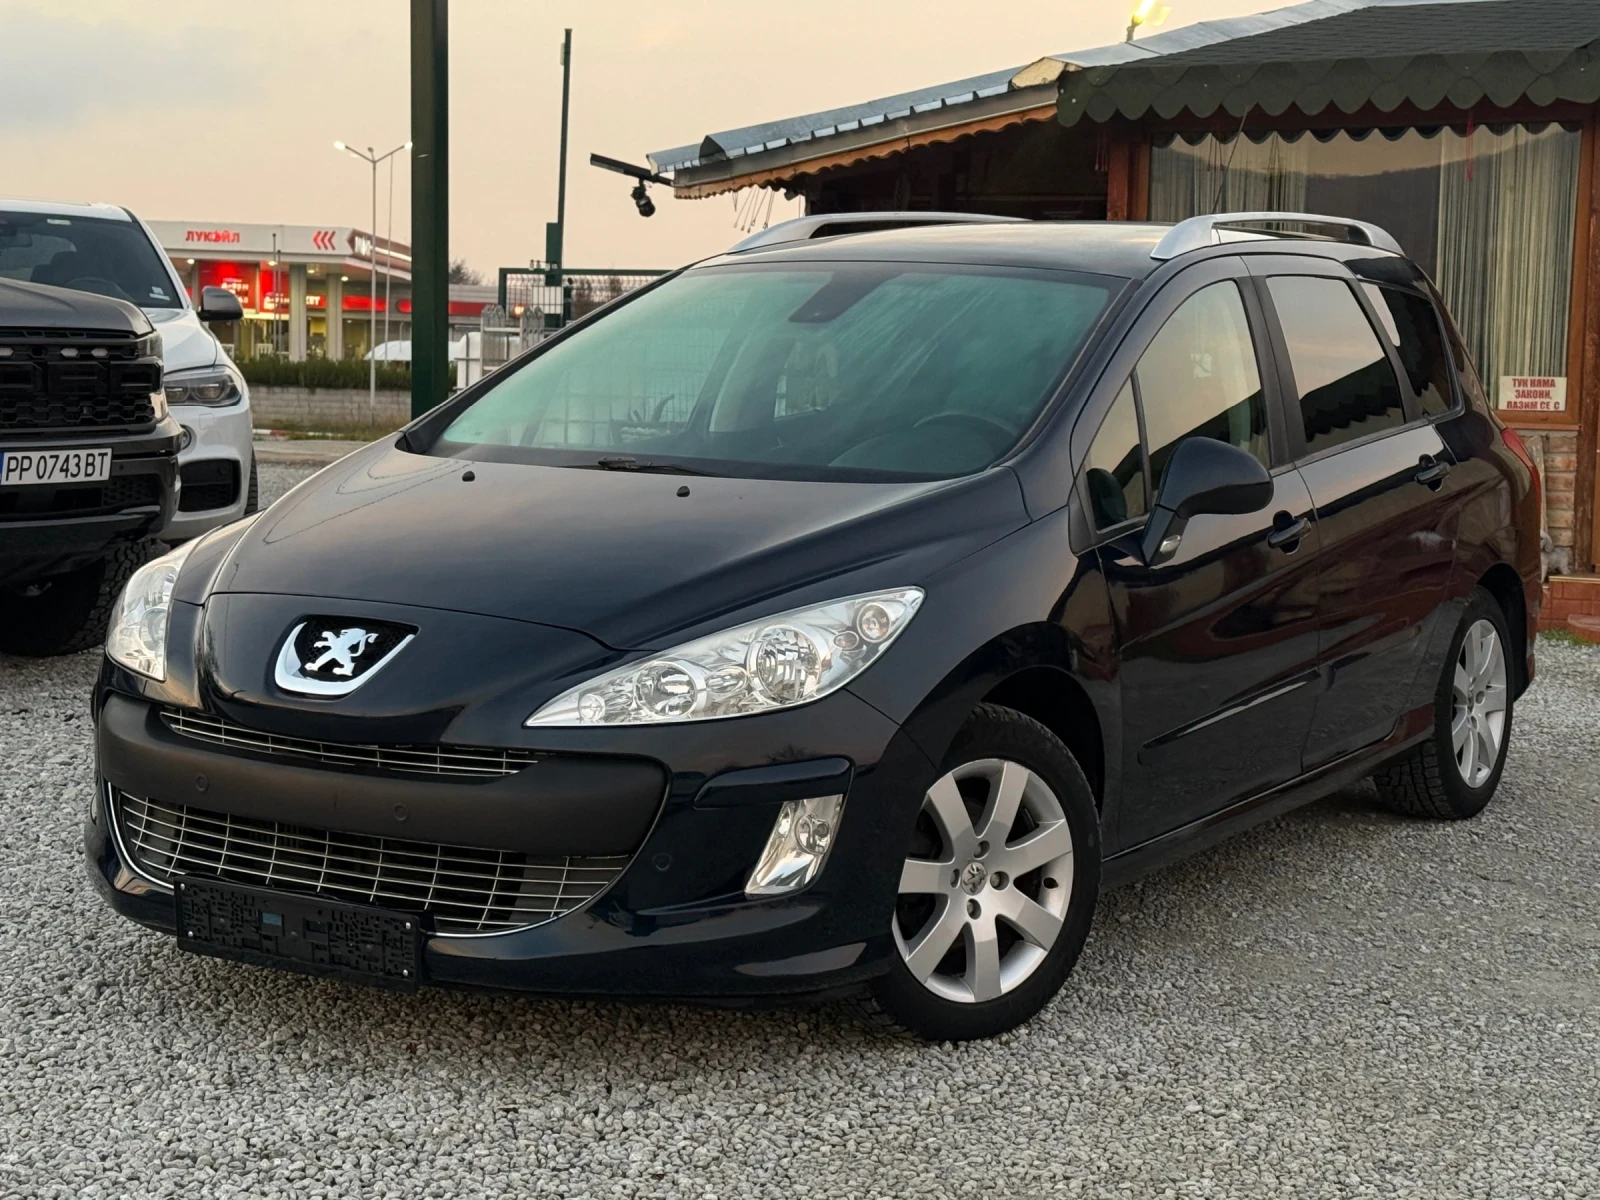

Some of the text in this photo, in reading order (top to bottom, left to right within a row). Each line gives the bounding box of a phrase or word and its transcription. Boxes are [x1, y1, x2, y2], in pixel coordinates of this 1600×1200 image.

[1512, 378, 1556, 388] ТУК НЯМА
[1507, 401, 1560, 410] ПАЗИМ СЕ С
